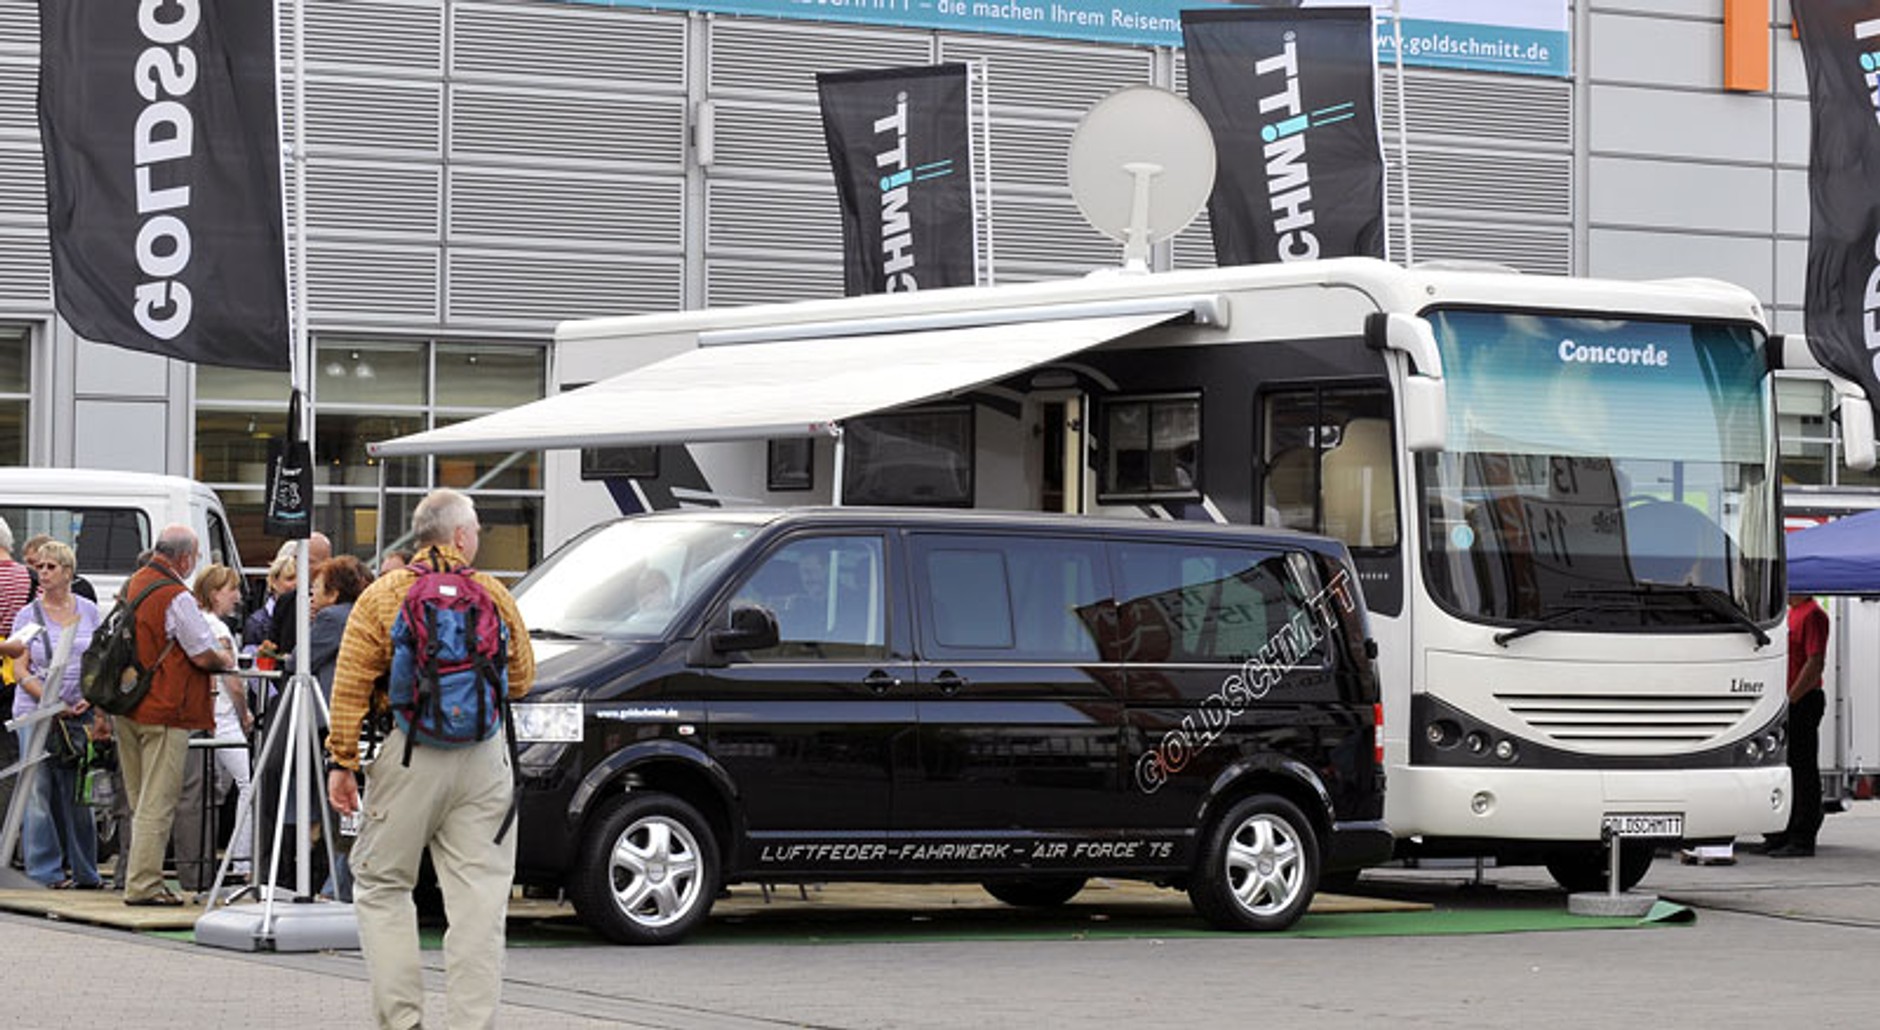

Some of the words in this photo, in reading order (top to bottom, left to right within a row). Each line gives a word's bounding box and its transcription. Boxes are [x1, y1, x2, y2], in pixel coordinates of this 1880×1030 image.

[937, 0, 967, 15] die
[973, 0, 1044, 20] machen
[1051, 5, 1104, 26] Ihrem
[1558, 339, 1668, 366] Concorde
[1135, 569, 1355, 794] GOLDSCHMITT
[1730, 677, 1764, 692] Liner
[761, 844, 1010, 861] LUFTFEDER-FAHRWERK
